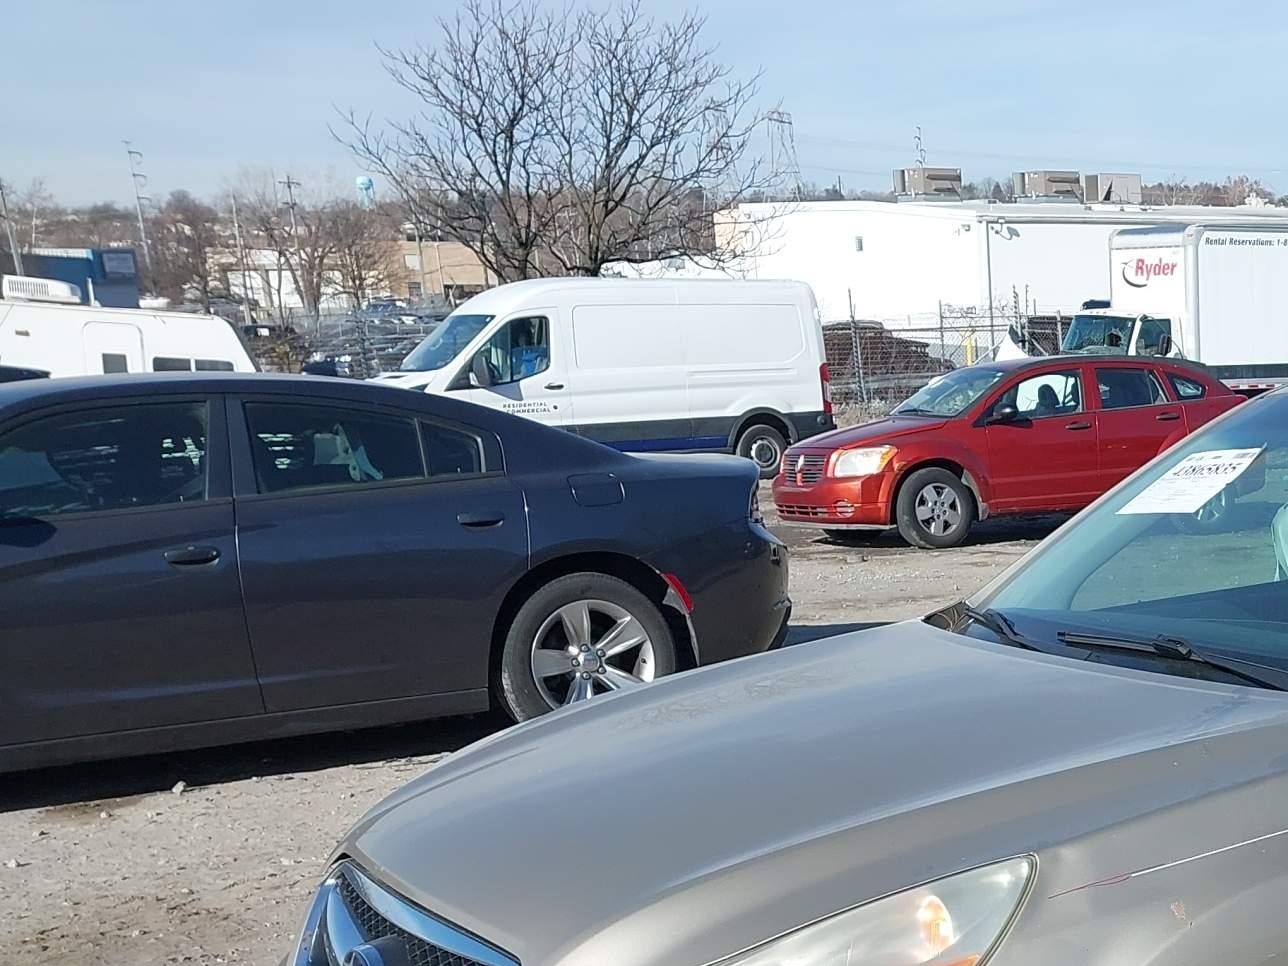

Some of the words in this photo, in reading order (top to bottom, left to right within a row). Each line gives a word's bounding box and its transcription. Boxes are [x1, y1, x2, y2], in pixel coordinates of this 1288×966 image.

[1205, 237, 1227, 246] Rental
[1229, 237, 1275, 247] Reservations:
[1135, 257, 1178, 281] Ryder
